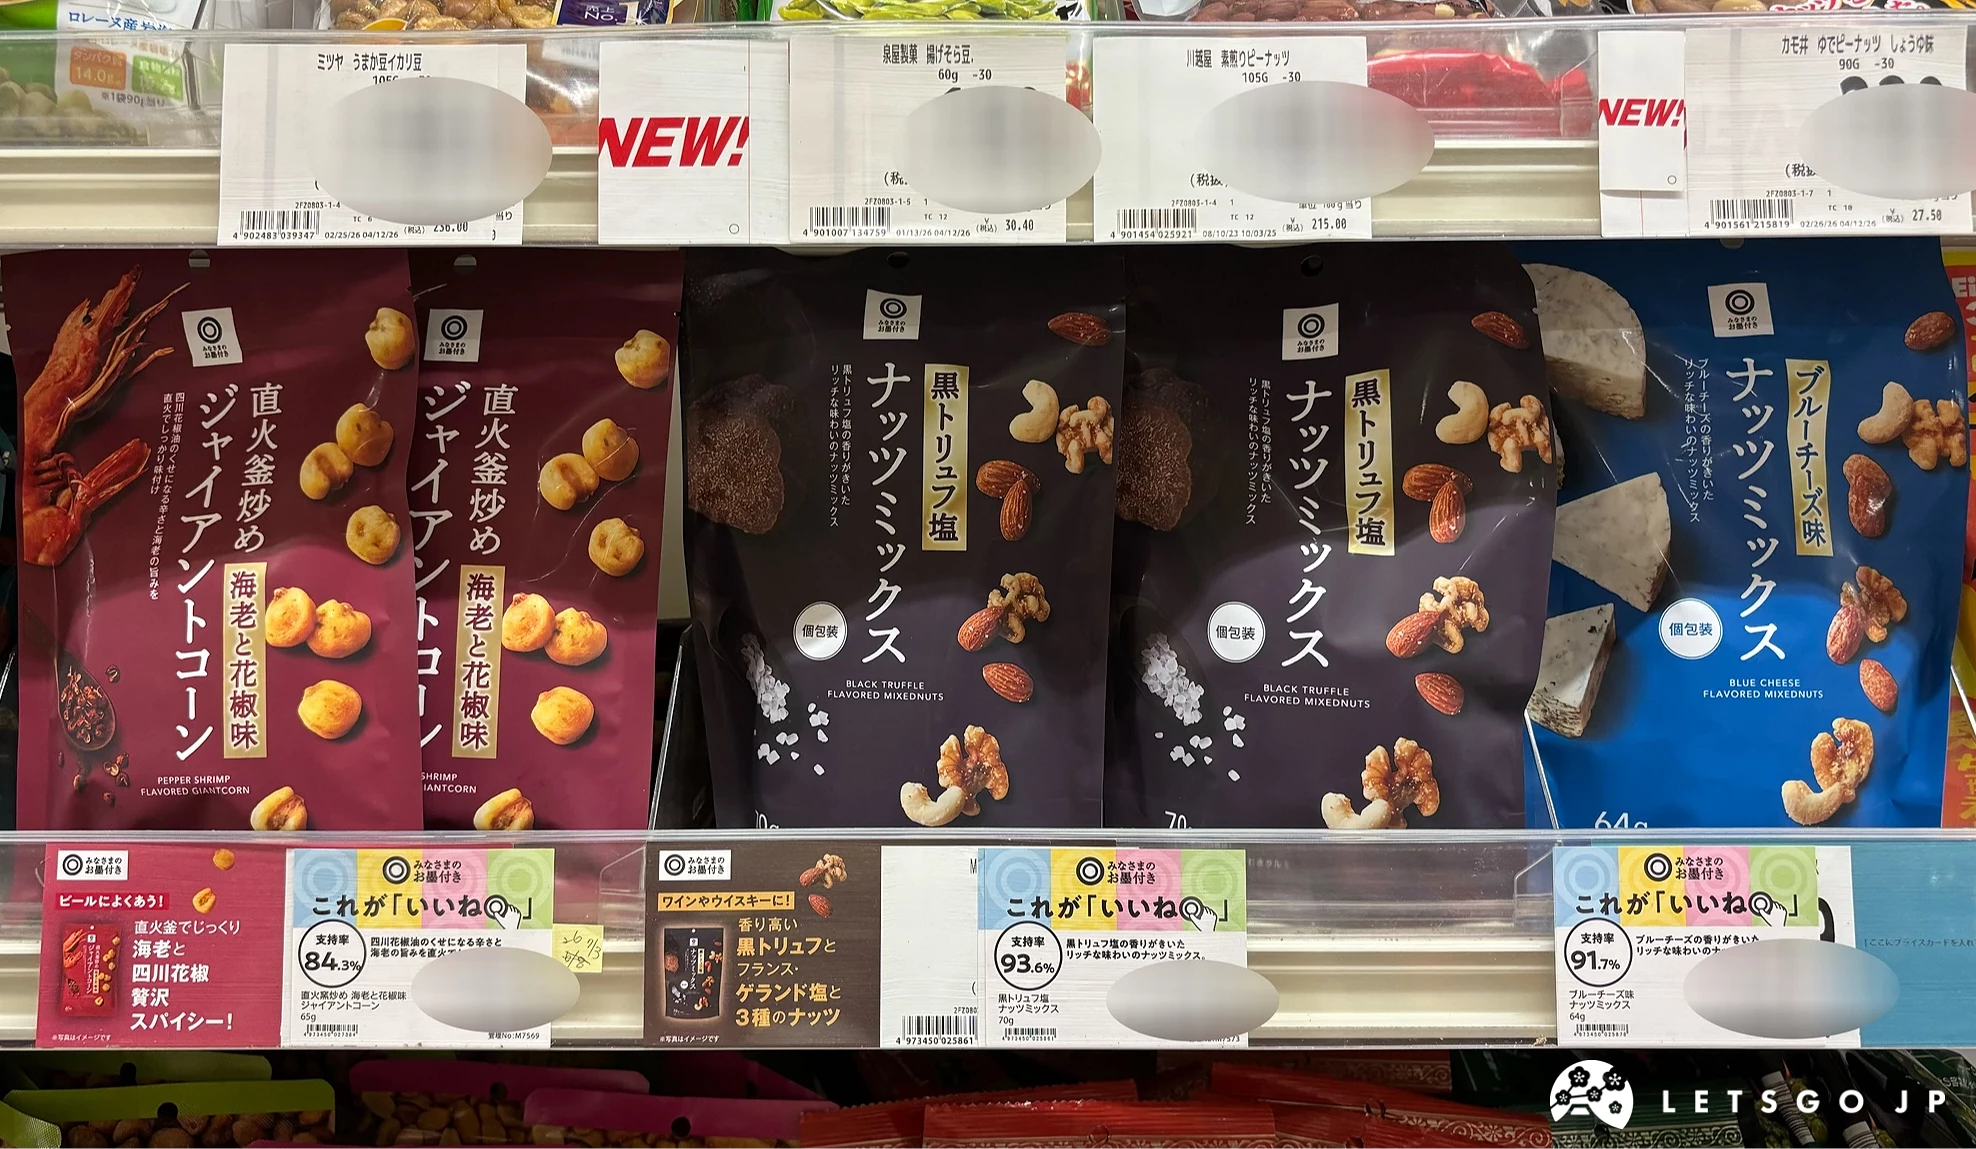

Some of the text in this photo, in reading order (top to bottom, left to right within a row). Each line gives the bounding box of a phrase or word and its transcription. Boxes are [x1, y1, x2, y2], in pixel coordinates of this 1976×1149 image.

[1782, 34, 1934, 54] カモ井 ゆでピーナッツ しょうゆ味
[883, 44, 918, 64] 泉屋製菓
[1186, 49, 1290, 67] 川越屋 素煎りピーナッツ
[317, 53, 422, 71] ミツヤ うまか豆イカリ豆
[1839, 58, 1894, 70] 90G -30
[938, 69, 992, 83] 60g -30
[1241, 72, 1301, 83] 105G -30
[1598, 98, 1685, 127] NEW!
[598, 116, 749, 168] NEW!
[1766, 190, 1813, 198] 2FZ0803-1-7
[295, 201, 341, 209] 2FZ0803-1-4
[865, 198, 911, 206] 2FZ0803-1-5
[1171, 199, 1217, 207] 2FZ0803-1-4
[1912, 209, 1942, 222] 27.50
[1005, 219, 1034, 232] 30.40
[1311, 218, 1347, 230] 215.00
[1715, 221, 1750, 229] 901561
[1754, 221, 1790, 229] 215819
[1800, 219, 1876, 229] 02/26/26 04/12/26
[243, 232, 278, 240] 902483
[280, 232, 315, 240] 039347
[324, 231, 398, 239] 02/25/26 04/12/26
[802, 229, 886, 237] 4 901007 134759
[896, 229, 971, 237] 01/13/26 04/12/26
[1110, 231, 1192, 239] 4 901454 025921
[1202, 229, 1277, 238] 08/10/23 10/03/25
[841, 364, 852, 506] 黒トリュフ塩の香りがきいた
[1698, 358, 1714, 501] ブルーチーズの香りがきいた
[150, 393, 173, 495] 直火でしっかり味付け
[829, 364, 839, 527] リッチな味わいのナッツミックス
[1260, 379, 1272, 504] 黒トリュフ塩の香りがきいた
[1684, 358, 1700, 523] リッチな味わいのナッツミックス
[928, 371, 960, 541] 黒トリュフ塩
[1245, 377, 1259, 525] リッチな味わいのナッツミックス
[1793, 365, 1827, 547] ブルーチーズ味
[234, 382, 283, 553] 直火釜炒め
[1351, 378, 1386, 546] 黒トリュフ塩
[469, 383, 519, 555] 直火釜炒め
[149, 392, 185, 600] 四川花椒油のくせになる辛さと海老の旨みを
[861, 362, 911, 664] ナッツミックス
[1726, 358, 1786, 661] ナッツミックス
[1281, 380, 1332, 668] ナッツミックス
[175, 383, 239, 761] ジャイアントコーン
[802, 624, 838, 639] 個包装
[1216, 625, 1256, 641] 個包装
[1668, 622, 1713, 637] 個包装
[230, 571, 258, 750] 海老と花椒味
[460, 573, 495, 749] 海老と花椒味
[846, 680, 925, 690] BLACK TRUFFLE
[1729, 678, 1801, 688] BLUE CHEESE
[827, 689, 944, 701] FLAVORED MIXEDNUTS
[1263, 683, 1350, 697] BLACK TRUFFLE
[1703, 689, 1824, 699] FLAVORED MIXEDNUTS
[1244, 694, 1370, 709] FLAVORED MIXEDNUTS
[157, 775, 231, 785] PEPPER SHRIMP
[140, 786, 250, 797] FLAVORED GIANTCORN
[86, 856, 122, 865] みなさまの
[413, 860, 462, 870] みなさまの
[688, 856, 725, 865] みなさまの
[1107, 861, 1156, 871] みなさまの
[1675, 857, 1724, 867] みなさまの
[85, 864, 122, 875] お墨付き
[688, 864, 725, 875] お墨付き
[1675, 867, 1724, 880] お墨付き
[413, 870, 462, 883] お墨付き
[1107, 871, 1156, 885] お墨付き
[59, 895, 164, 908] ビールによくあう!
[662, 895, 791, 909] ワインやウイスキーに!
[134, 920, 241, 935] 直火釜でじっくり
[738, 918, 798, 932] 香り高い
[316, 934, 349, 945] 支持率
[371, 937, 502, 947] 四川花椒油のくせになる辛さと
[1011, 936, 1045, 948] 支持率
[1066, 938, 1185, 949] 黒トリュフ塩の香りがきいた
[1581, 933, 1615, 944] 支持率
[132, 940, 186, 959] 海老と
[737, 938, 836, 957] 黒トリュフと
[304, 952, 361, 971] 84.3%
[1066, 950, 1206, 960] リッチな味わいのナッツミックス。
[1571, 950, 1621, 970] 91.7%
[1001, 953, 1055, 973] 93.6%
[132, 964, 209, 983] 四川花椒
[737, 963, 799, 977] フランス・
[131, 988, 170, 1007] 贅沢
[351, 991, 407, 1000] 海老と花椒味
[735, 983, 842, 1003] ゲランド塩と
[998, 993, 1049, 1003] 黒トリュフ塩
[1569, 990, 1634, 1000] ブルーチーズ味
[301, 1001, 380, 1010] ジャイアントコーン
[998, 1004, 1060, 1014] ナッツミックス
[1569, 1000, 1631, 1010] ナッツミックス
[130, 1012, 233, 1031] スパイシー!
[300, 1013, 317, 1022] 65g
[735, 1008, 841, 1027] 3種のナッツ
[998, 1016, 1014, 1026] 70g
[1569, 1012, 1586, 1022] 64g
[896, 1037, 973, 1045] 4 973450 025861
